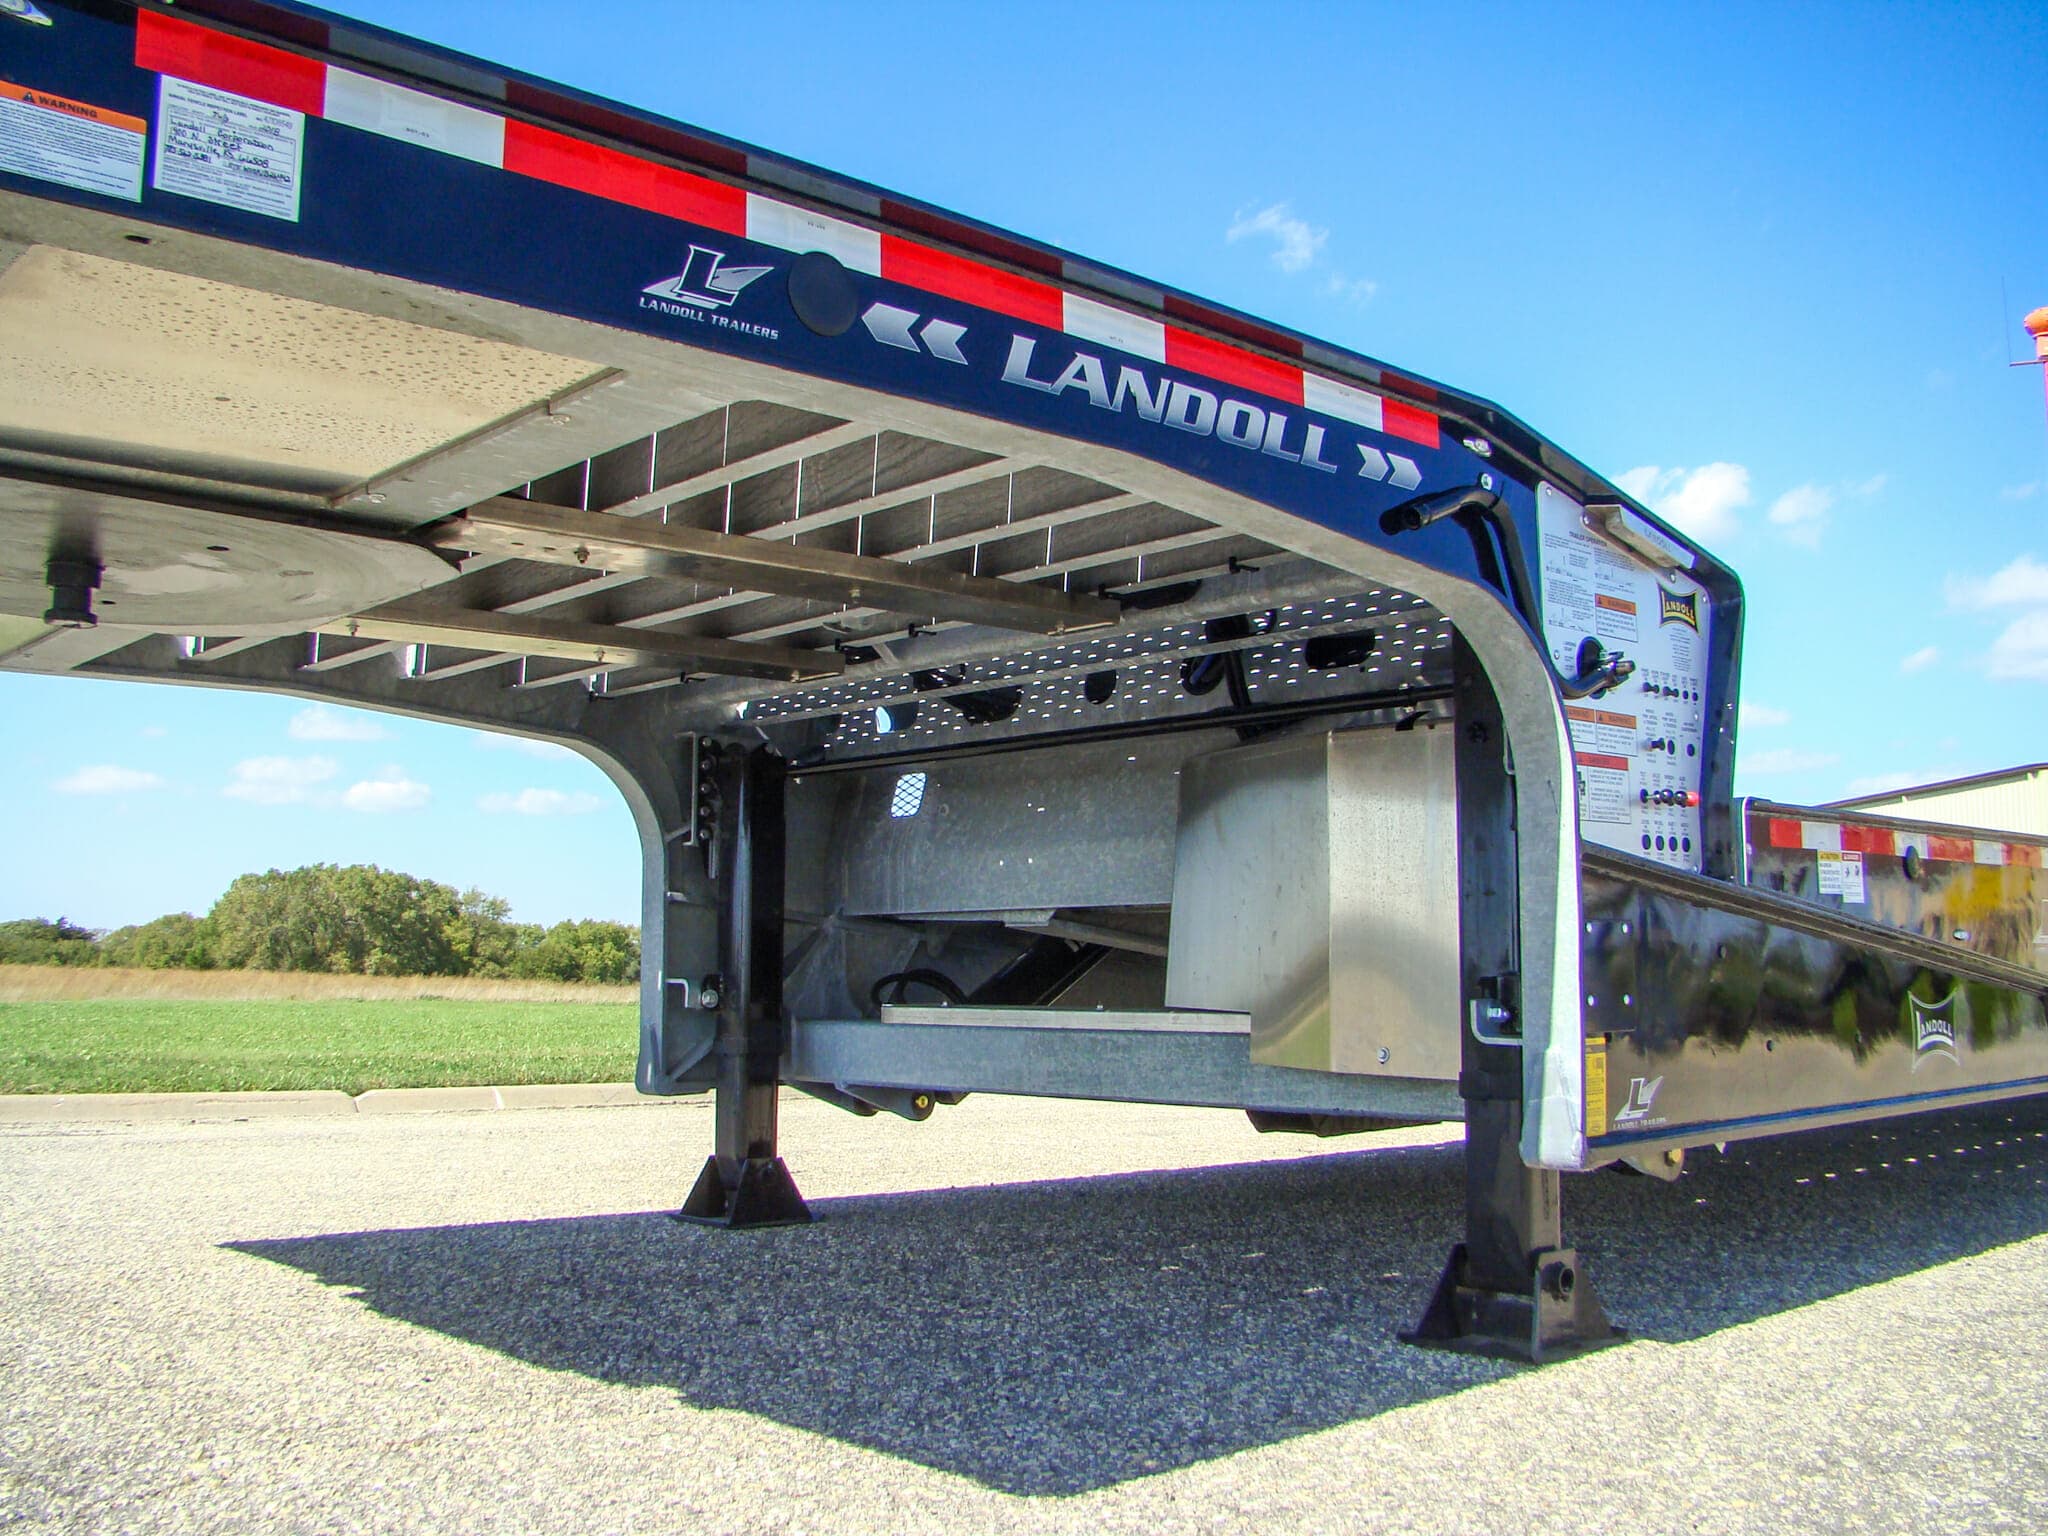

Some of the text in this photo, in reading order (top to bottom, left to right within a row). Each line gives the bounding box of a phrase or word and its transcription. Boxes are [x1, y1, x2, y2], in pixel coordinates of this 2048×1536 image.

[38, 95, 98, 119] WARNING
[639, 296, 780, 341] LANDOLL TRAILERS
[1000, 333, 1338, 475] LANDOLL
[1661, 591, 1695, 624] LANDOLL
[1915, 1010, 1953, 1049] LANDOLL
